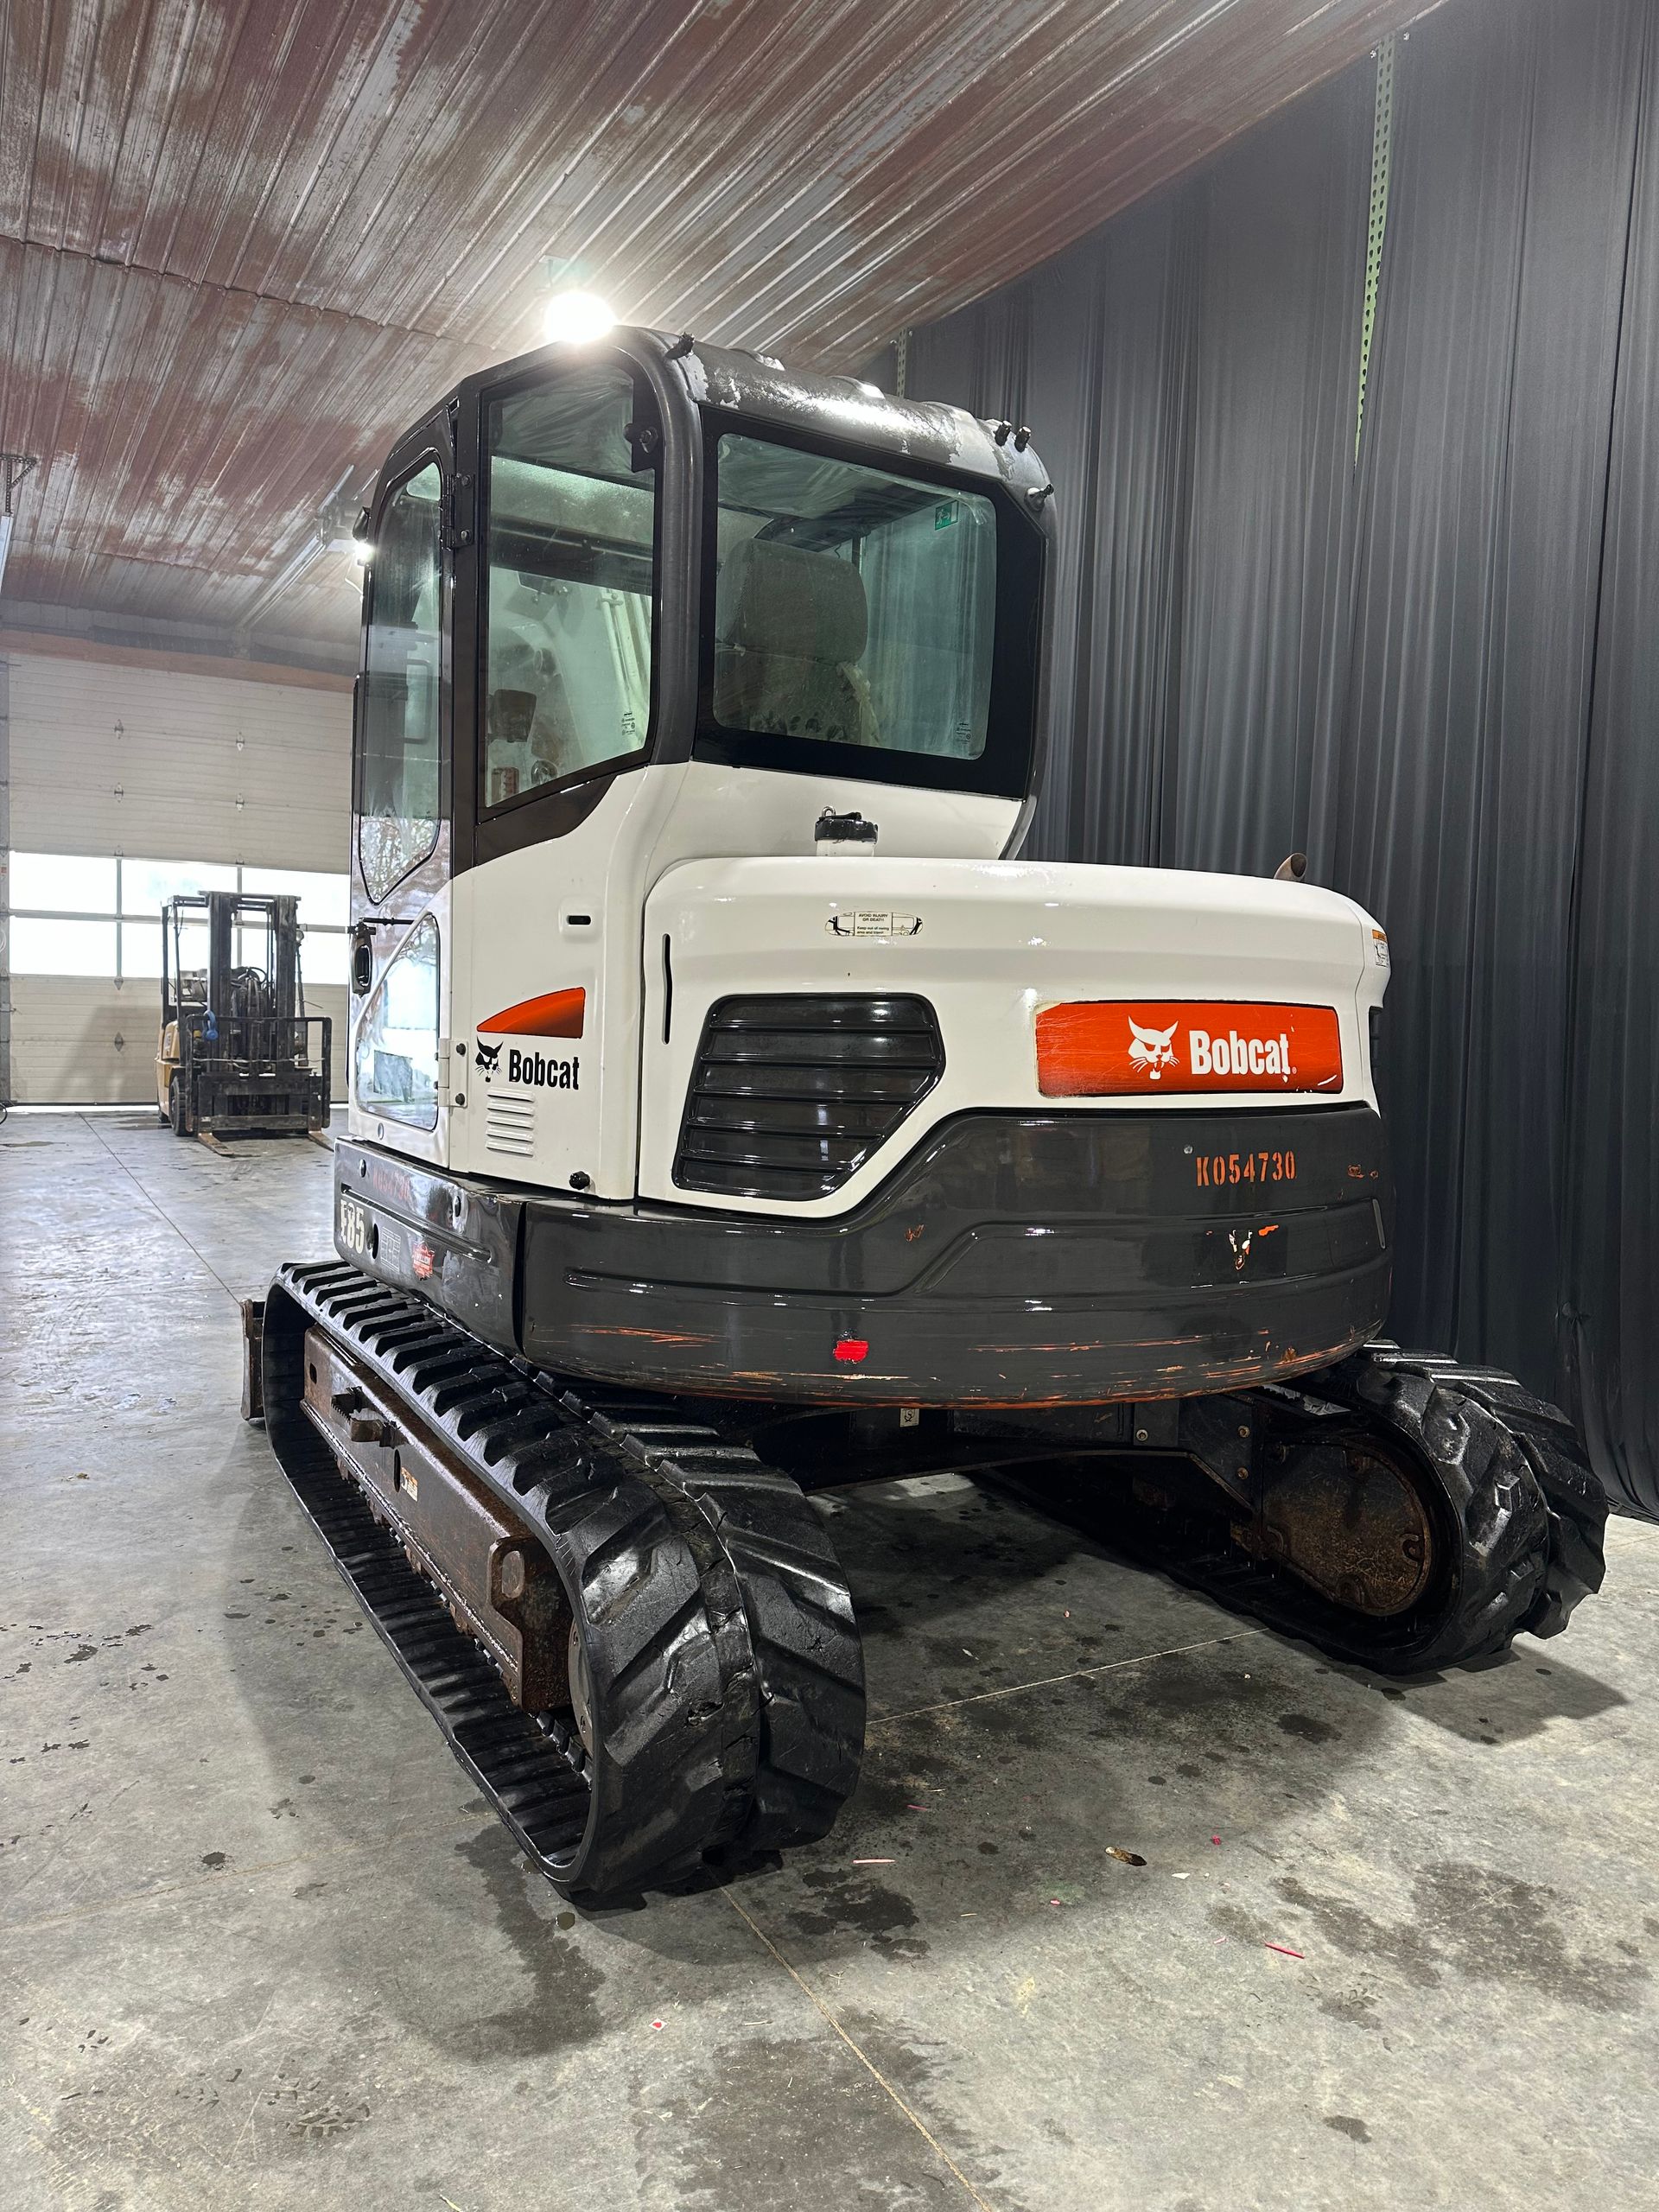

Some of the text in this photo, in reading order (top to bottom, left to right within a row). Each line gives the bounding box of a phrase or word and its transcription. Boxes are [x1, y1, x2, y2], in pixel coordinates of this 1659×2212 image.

[509, 1049, 580, 1090] Bobcat
[1189, 1030, 1291, 1075] Bobcat
[1196, 1150, 1297, 1187] K054730
[340, 1199, 365, 1255] E85
